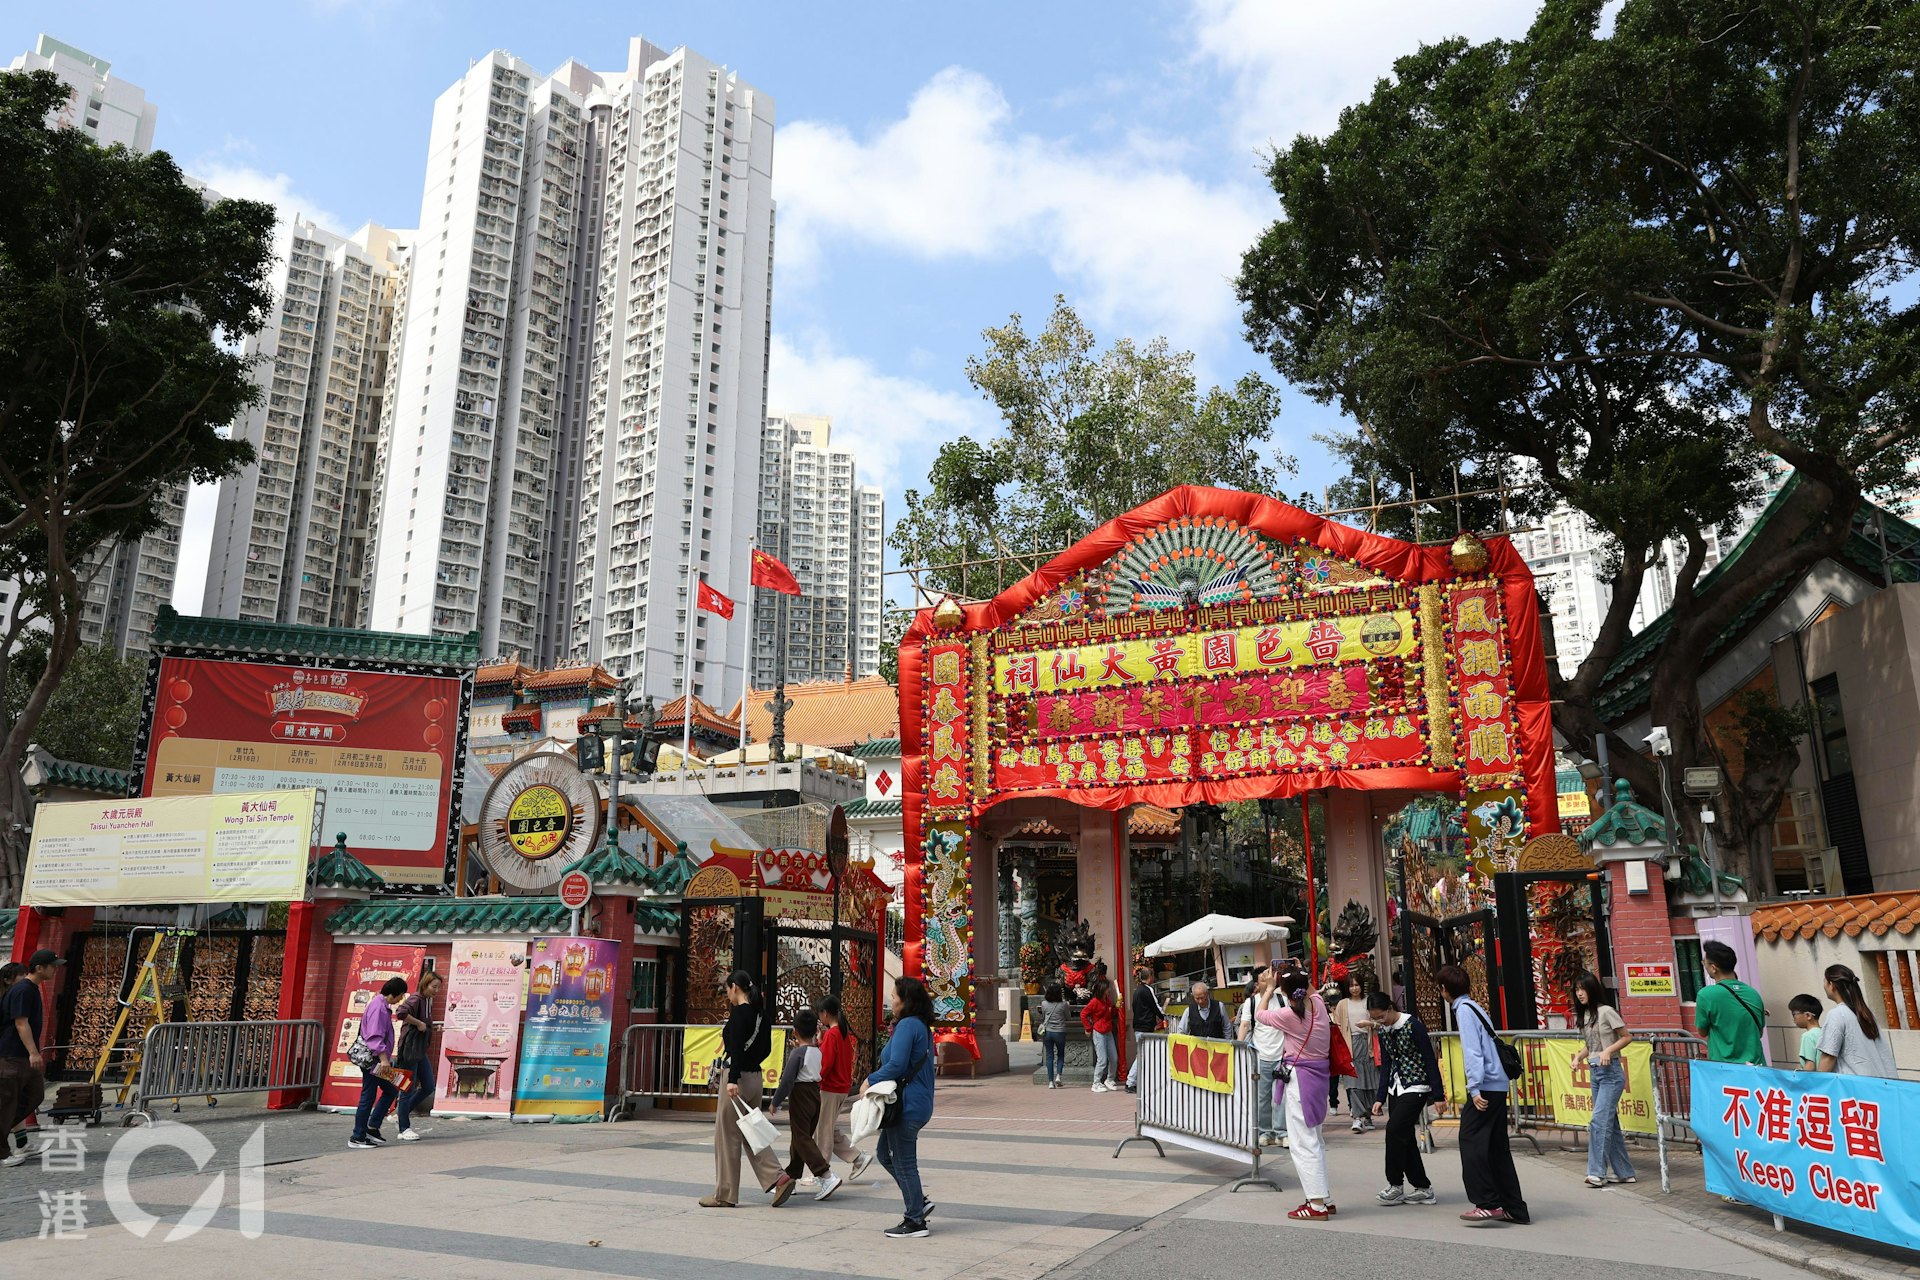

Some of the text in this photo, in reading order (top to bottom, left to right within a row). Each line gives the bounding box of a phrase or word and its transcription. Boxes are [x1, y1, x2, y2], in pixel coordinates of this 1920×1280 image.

[1456, 596, 1511, 765] 風調雨順
[1046, 671, 1359, 733] 喜迎丙午年新春
[284, 725, 333, 739] 開放時間
[340, 753, 383, 761] 正月初二至十四
[166, 773, 200, 784] 黃大仙祠
[241, 800, 277, 813] 黃大仙祠
[101, 807, 143, 820] 太歲元辰殿
[224, 813, 294, 825] Wong Tai Sin Temple
[90, 820, 154, 831] Taisui Yuanchen Hall
[1630, 979, 1671, 987] 小心車輛出入
[1722, 1086, 1885, 1164] 不准逗留
[1735, 1148, 1882, 1212] Keep Clear
